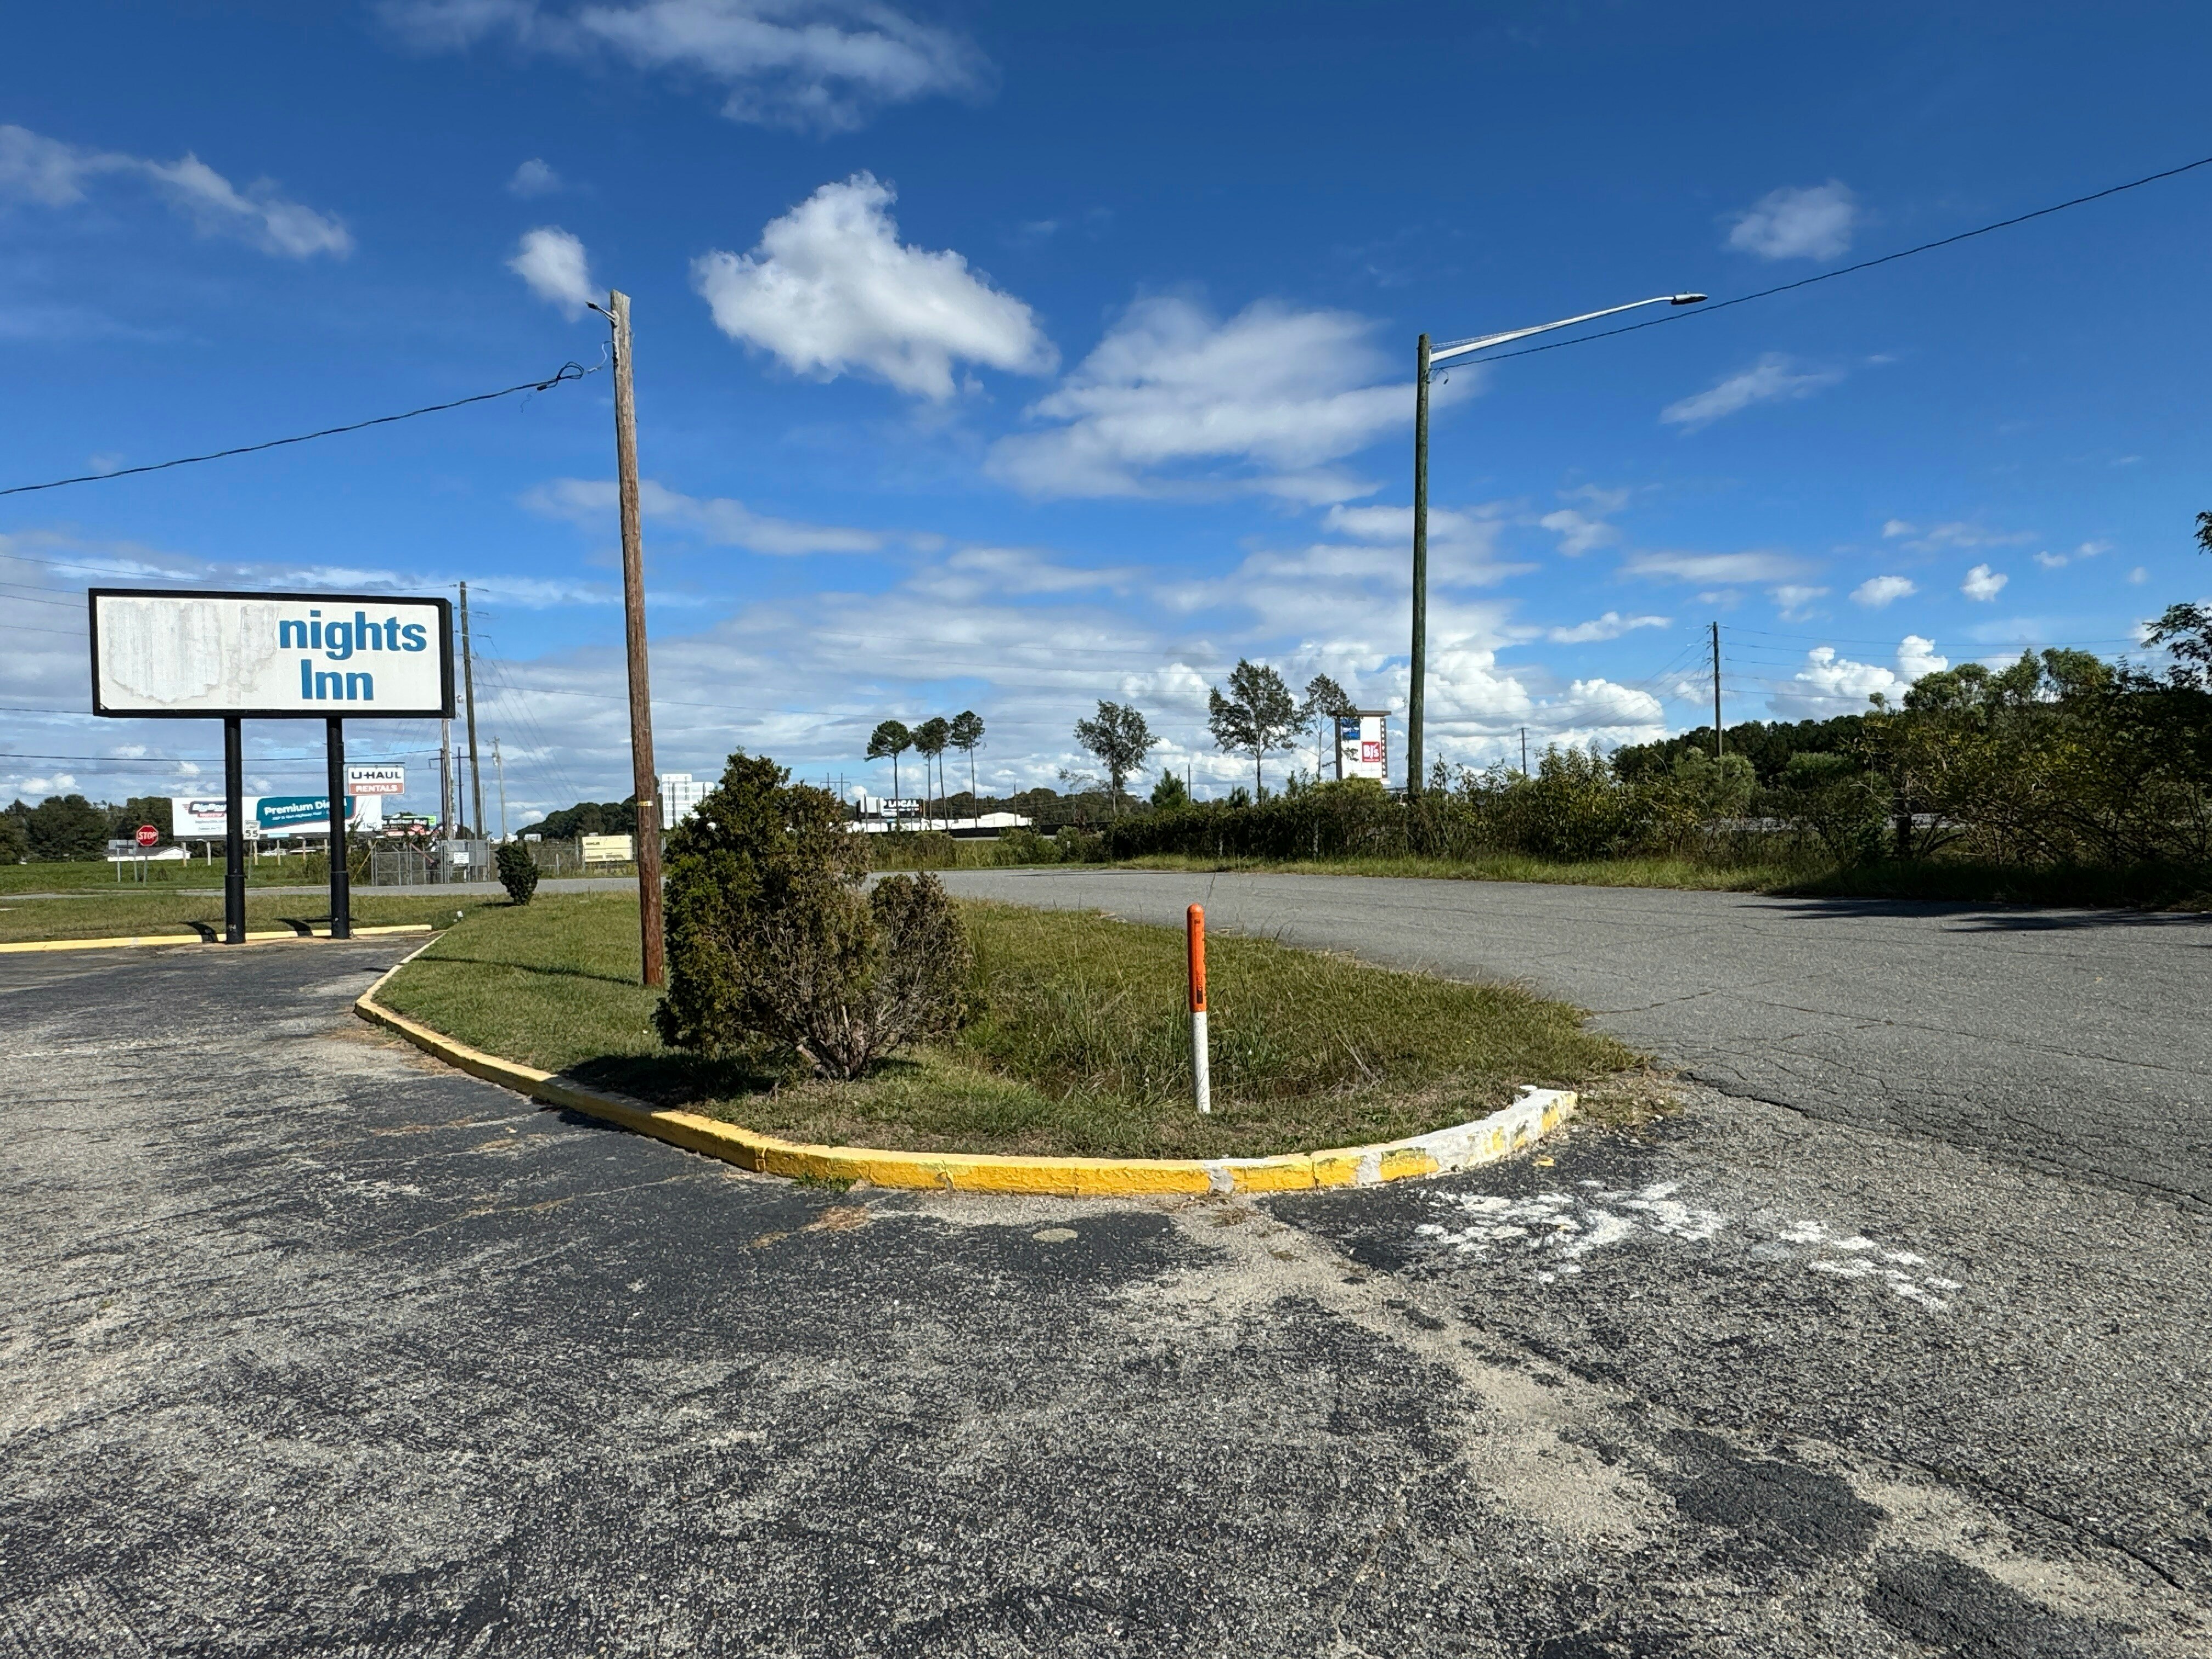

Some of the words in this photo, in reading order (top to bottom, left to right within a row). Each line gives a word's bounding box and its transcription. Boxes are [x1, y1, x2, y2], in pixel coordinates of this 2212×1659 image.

[279, 610, 427, 660] nights
[301, 659, 374, 701] Inn
[264, 803, 313, 816] Premium
[138, 832, 157, 840] STOP
